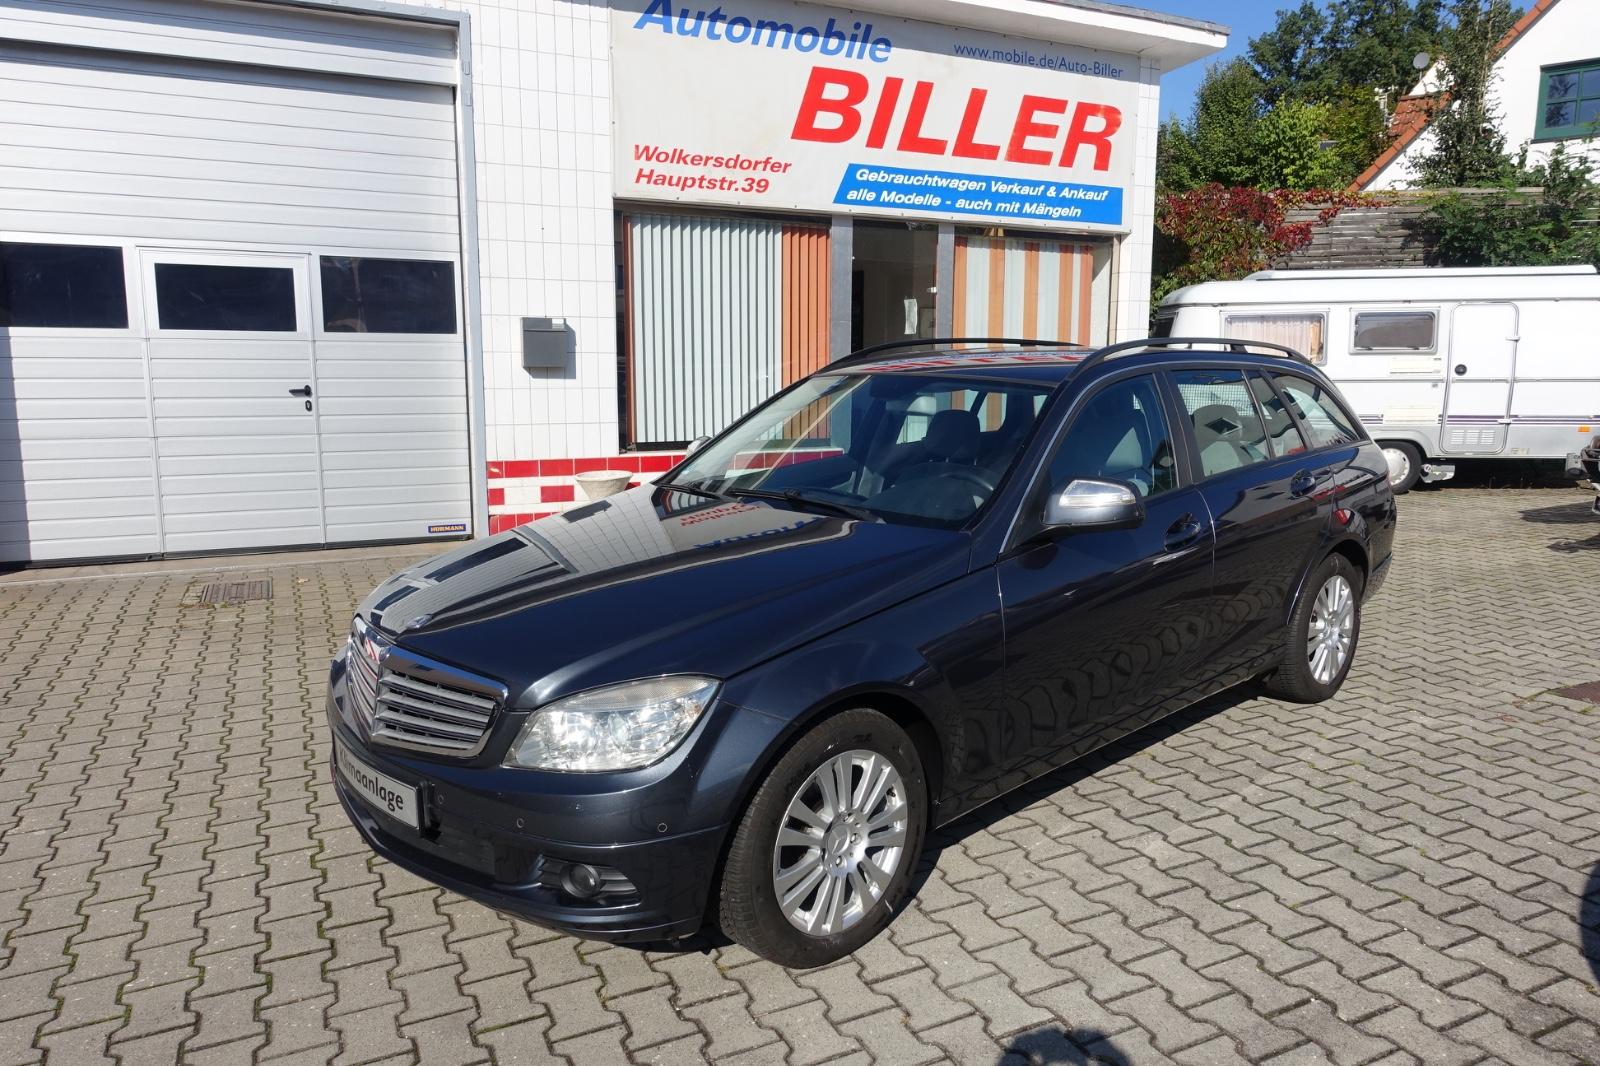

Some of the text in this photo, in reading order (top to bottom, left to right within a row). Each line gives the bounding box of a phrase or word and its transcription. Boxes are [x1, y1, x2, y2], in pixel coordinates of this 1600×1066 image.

[634, 0, 892, 63] Automobile
[953, 43, 1124, 78] www.mobile.de/Auto-Biller
[791, 66, 1122, 171] BILLER
[634, 144, 792, 173] Wolkersdorfer
[635, 168, 769, 193] Hauptstr.39
[856, 169, 1109, 201] Gebrauchtwagen Verkauf & Ankauf
[847, 189, 876, 202] alle
[880, 191, 942, 206] Modelle
[955, 198, 992, 210] auch
[995, 201, 1020, 213] mit
[1022, 203, 1082, 218] Mängeln
